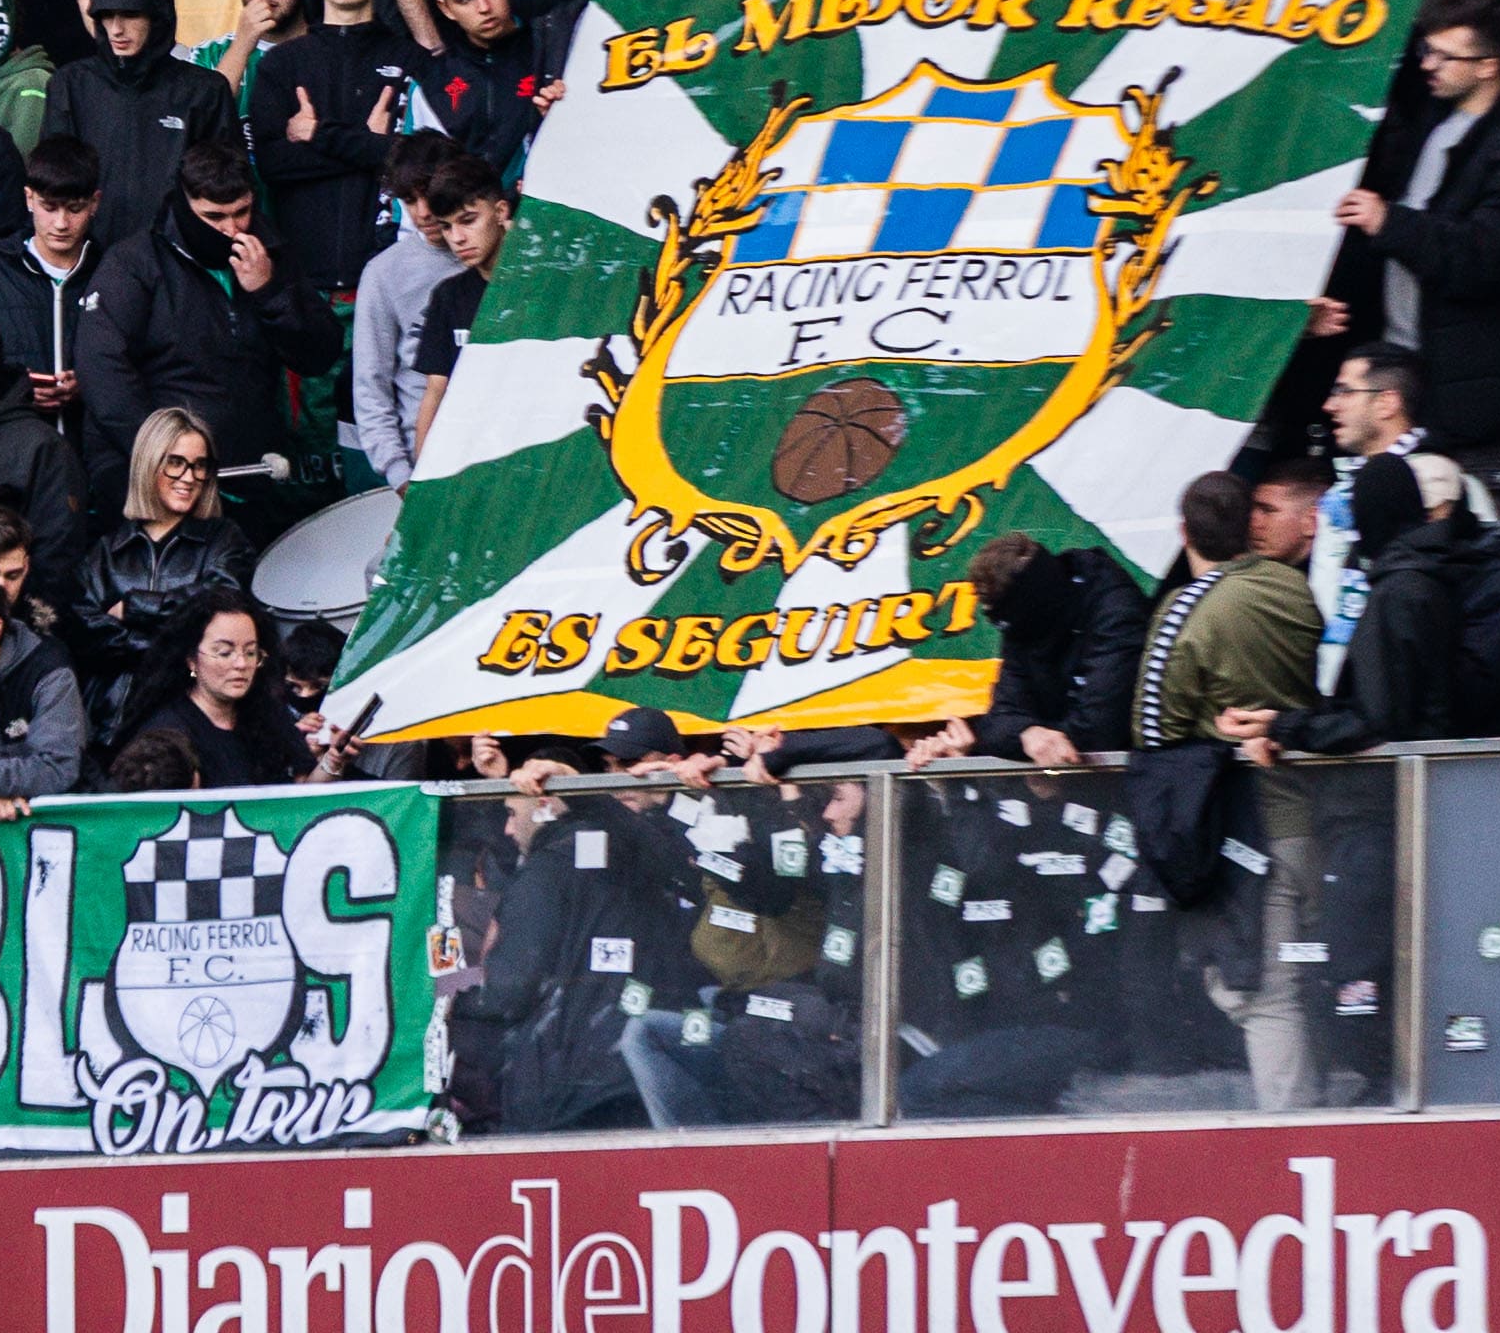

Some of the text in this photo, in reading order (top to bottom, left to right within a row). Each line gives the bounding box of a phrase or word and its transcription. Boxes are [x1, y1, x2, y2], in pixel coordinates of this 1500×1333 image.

[600, 24, 715, 92] EL
[718, 253, 1072, 317] RACING FERROL
[868, 307, 963, 356] C.
[478, 605, 593, 675] ES
[131, 920, 280, 953] RACING FERROL
[77, 1057, 206, 1156] On
